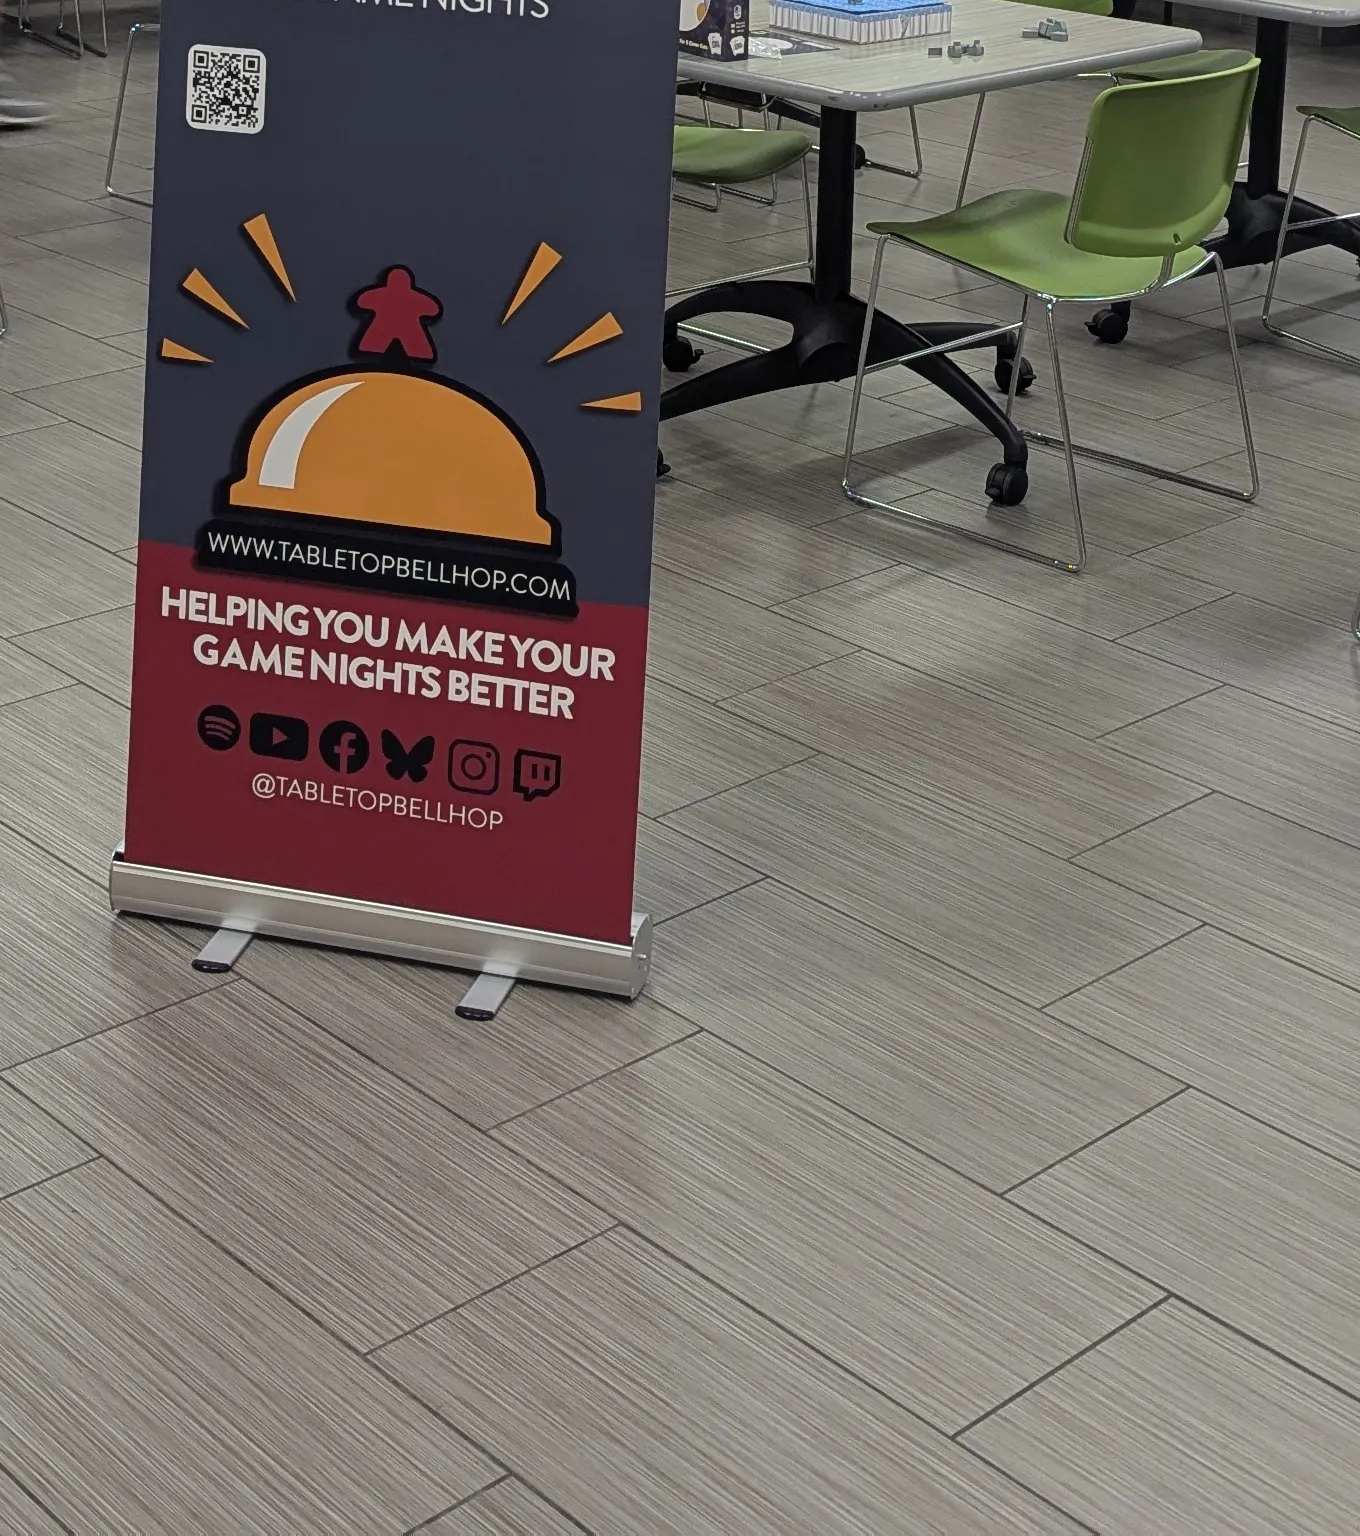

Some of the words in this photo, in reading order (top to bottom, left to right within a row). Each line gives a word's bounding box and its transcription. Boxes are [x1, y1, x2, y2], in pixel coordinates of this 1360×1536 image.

[207, 531, 571, 602] WWW.TABLETOPBELLHOP.COM
[161, 586, 309, 637] HELPING
[312, 607, 389, 648] YOU
[395, 619, 504, 665] MAKE
[508, 634, 616, 682] YOUR
[193, 634, 303, 679] GAME
[310, 651, 441, 700] NIGHTS
[448, 670, 575, 720] BETTER
[252, 773, 503, 831] @TABLETOPBELLHOP
